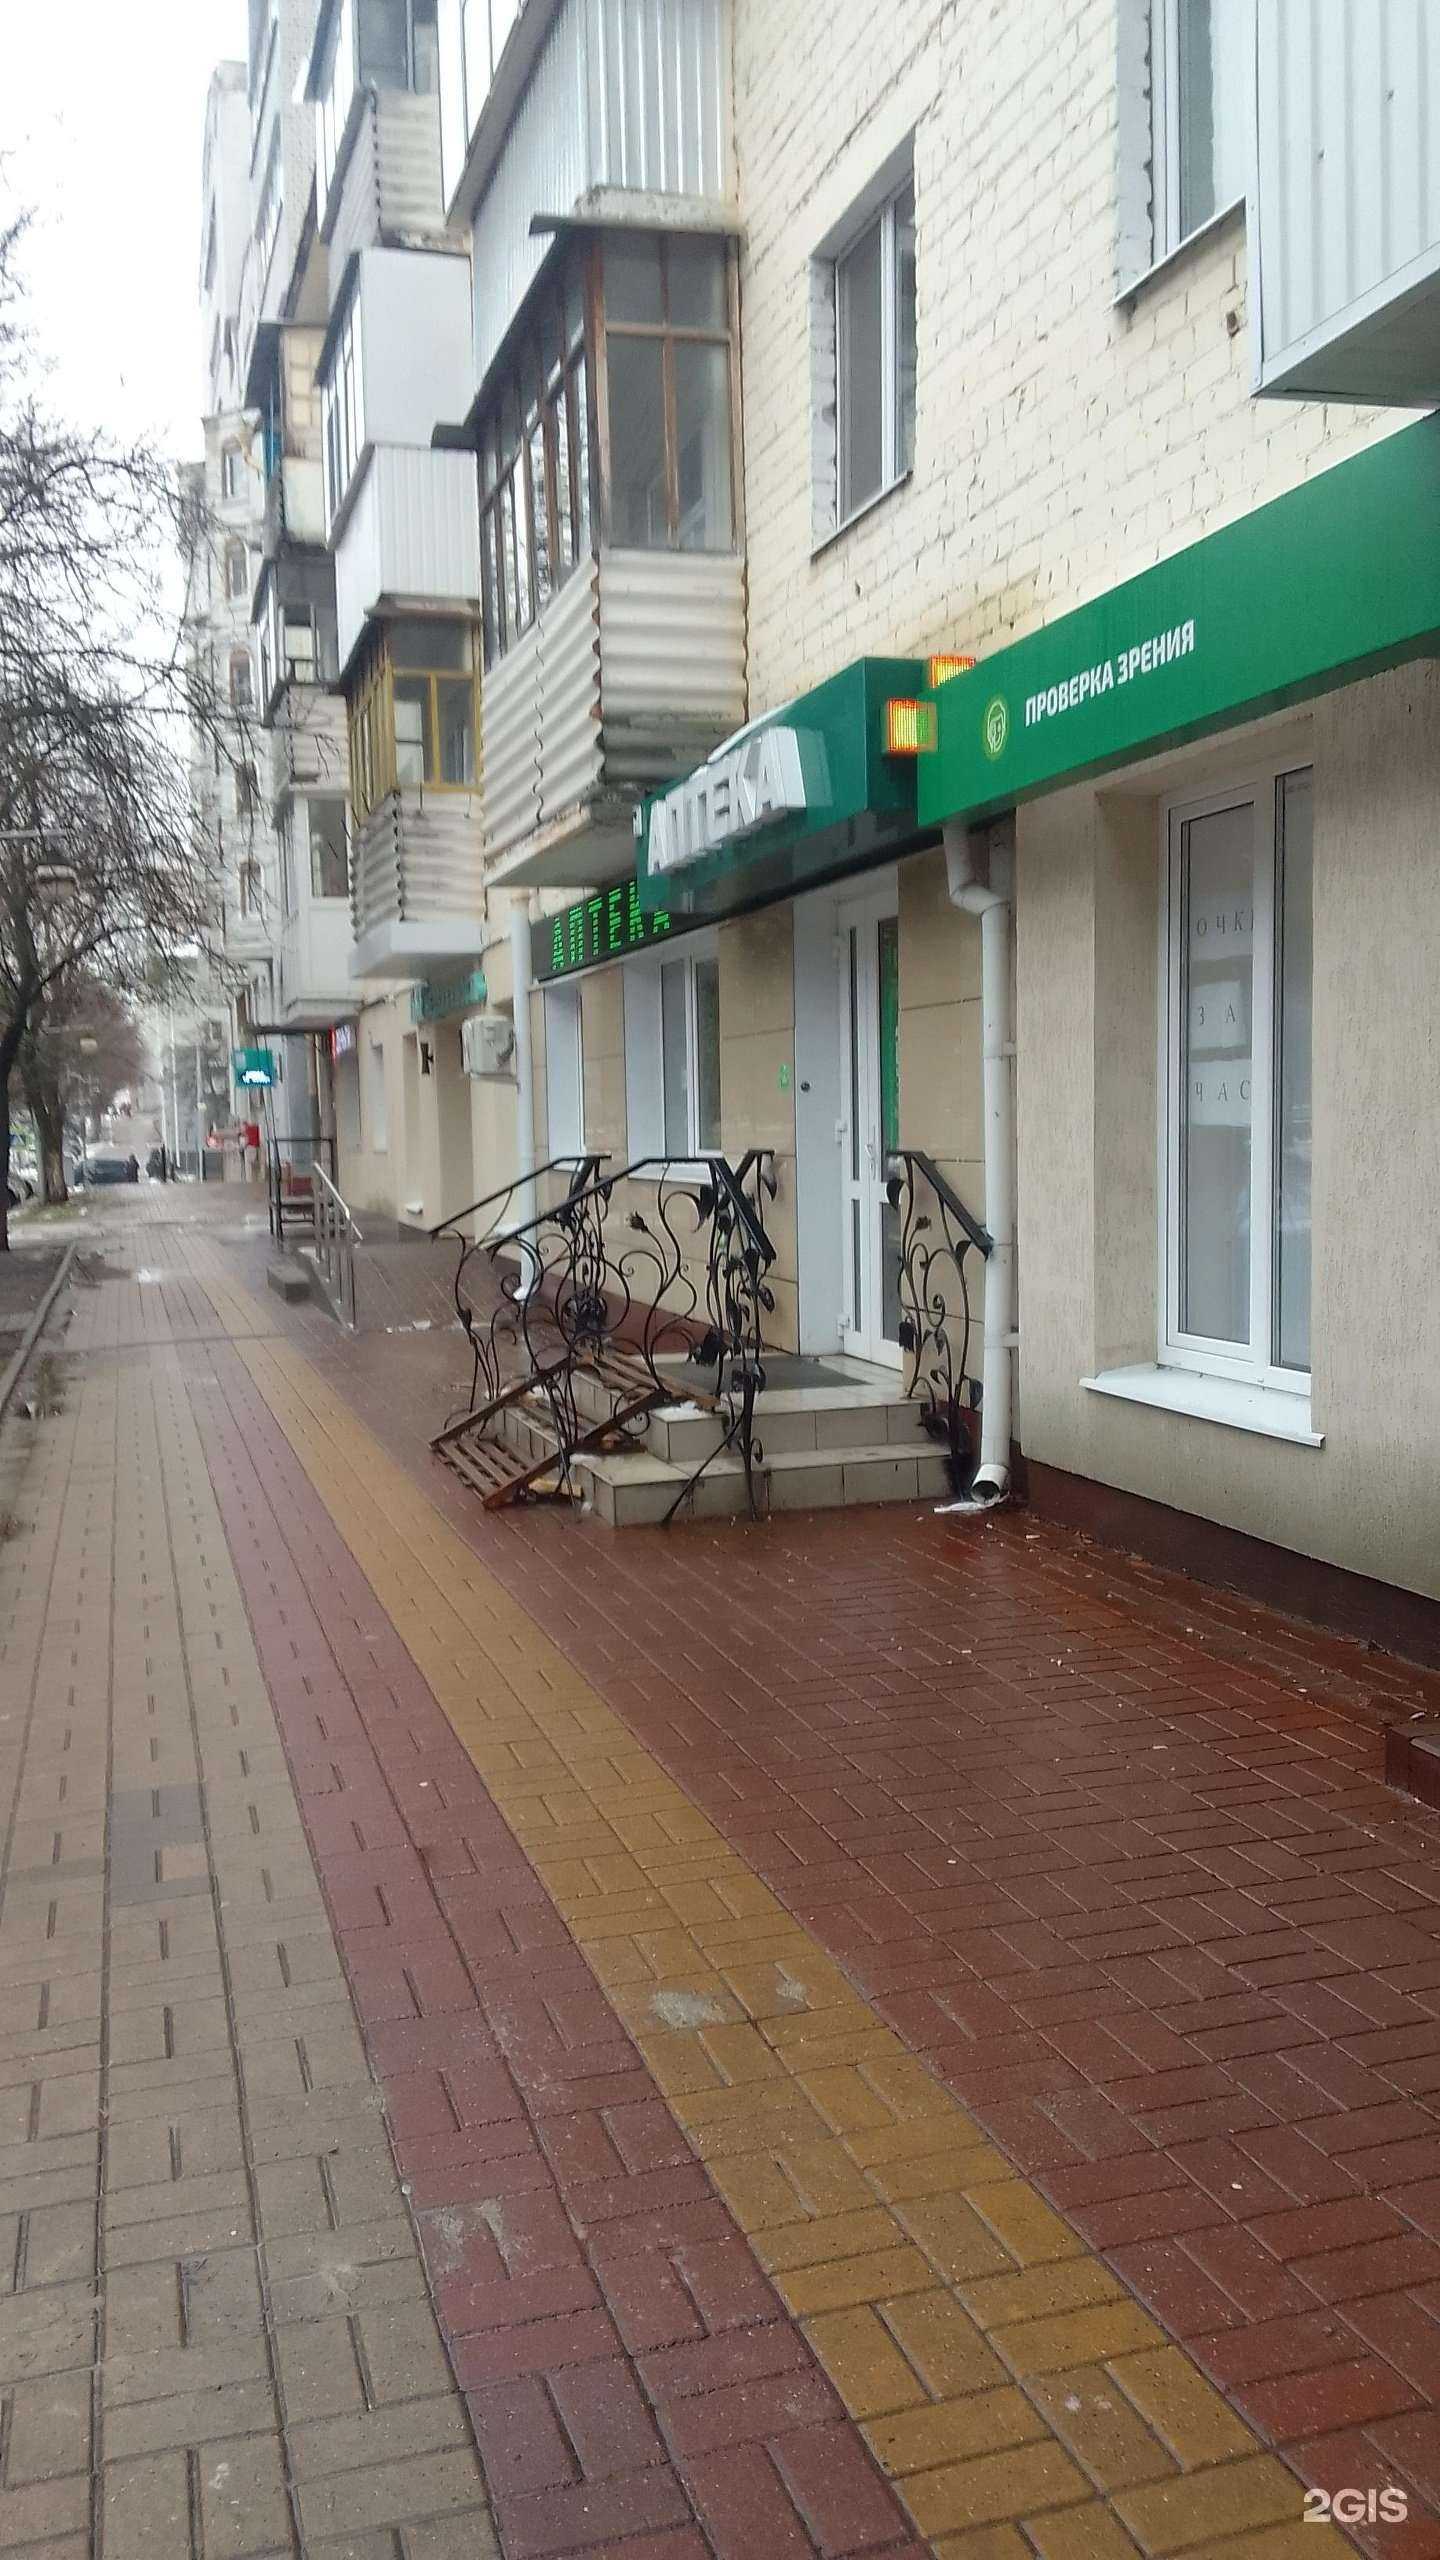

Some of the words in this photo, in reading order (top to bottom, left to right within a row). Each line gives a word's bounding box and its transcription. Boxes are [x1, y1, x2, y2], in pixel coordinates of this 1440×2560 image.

[1025, 660, 1114, 727] ПРОВЕРКА
[1117, 619, 1195, 684] ЗРЕНИЯ
[648, 726, 806, 876] АПТЕКА
